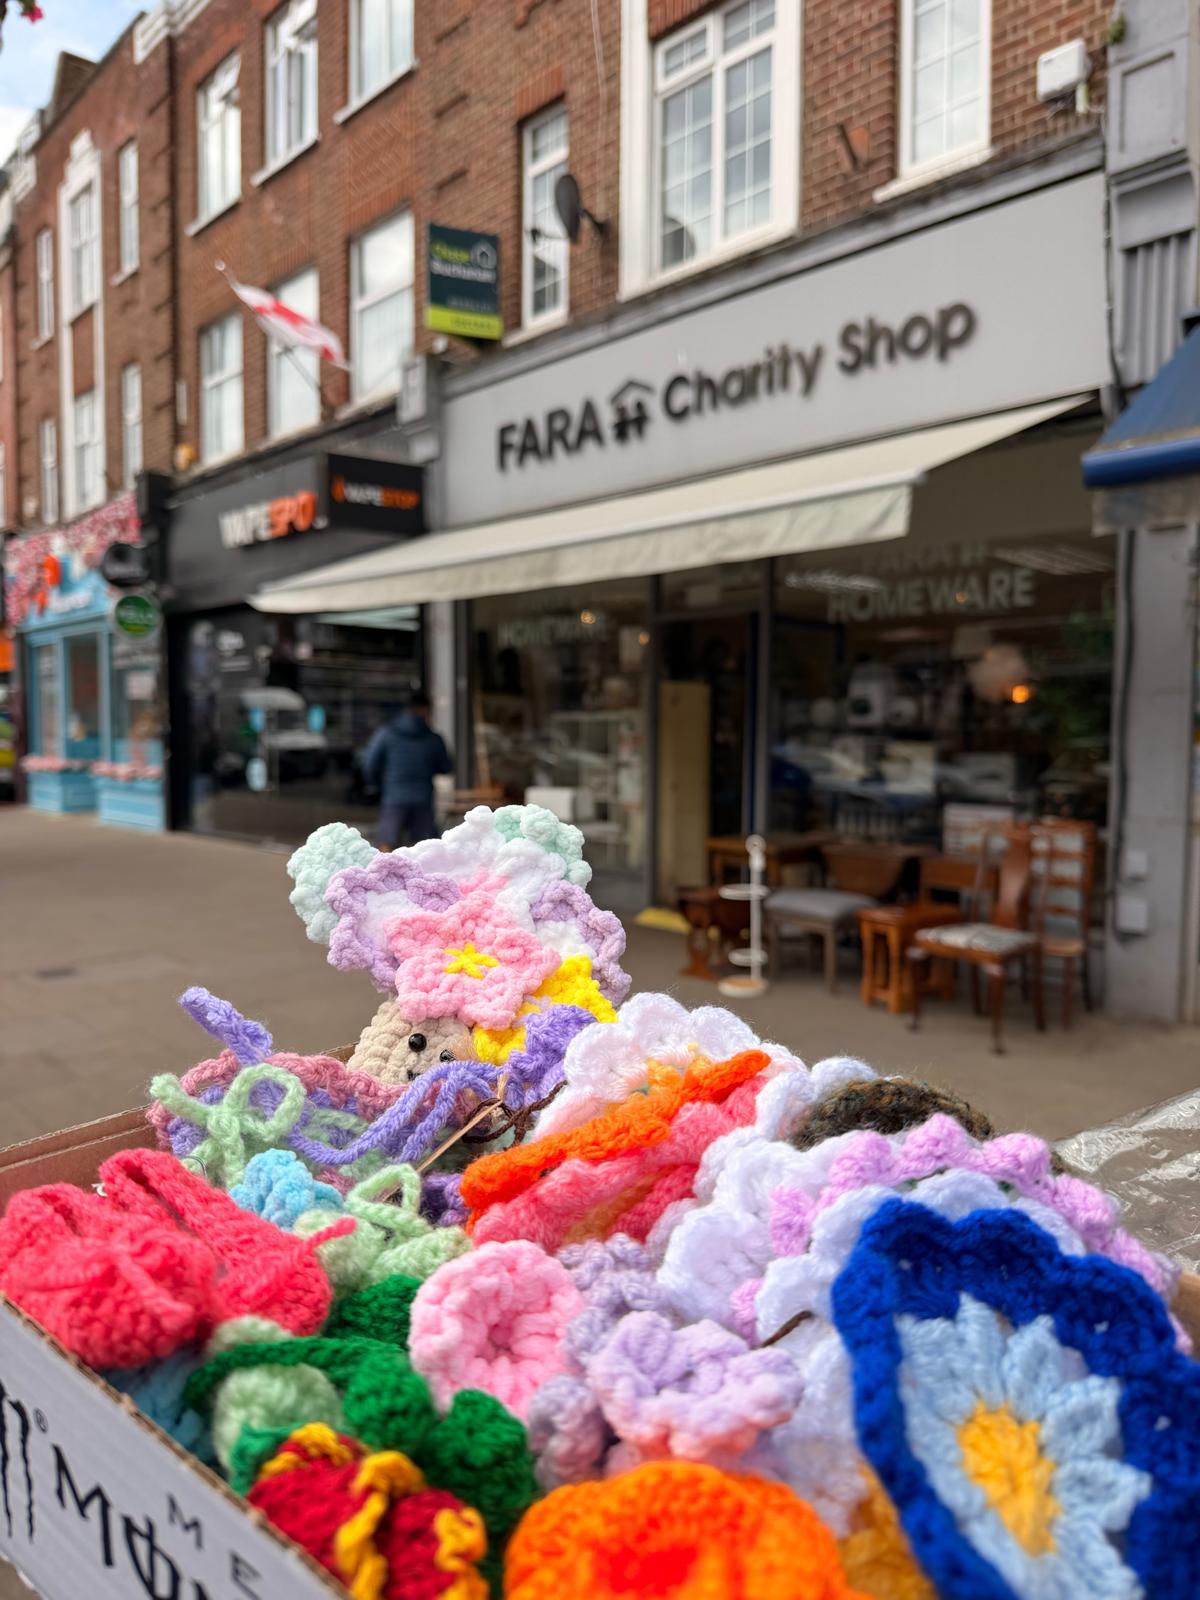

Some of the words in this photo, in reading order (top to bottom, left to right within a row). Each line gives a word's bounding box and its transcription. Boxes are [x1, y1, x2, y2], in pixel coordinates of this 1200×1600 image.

[497, 398, 605, 470] FARA
[662, 341, 825, 421] Charity
[837, 301, 977, 376] Shop
